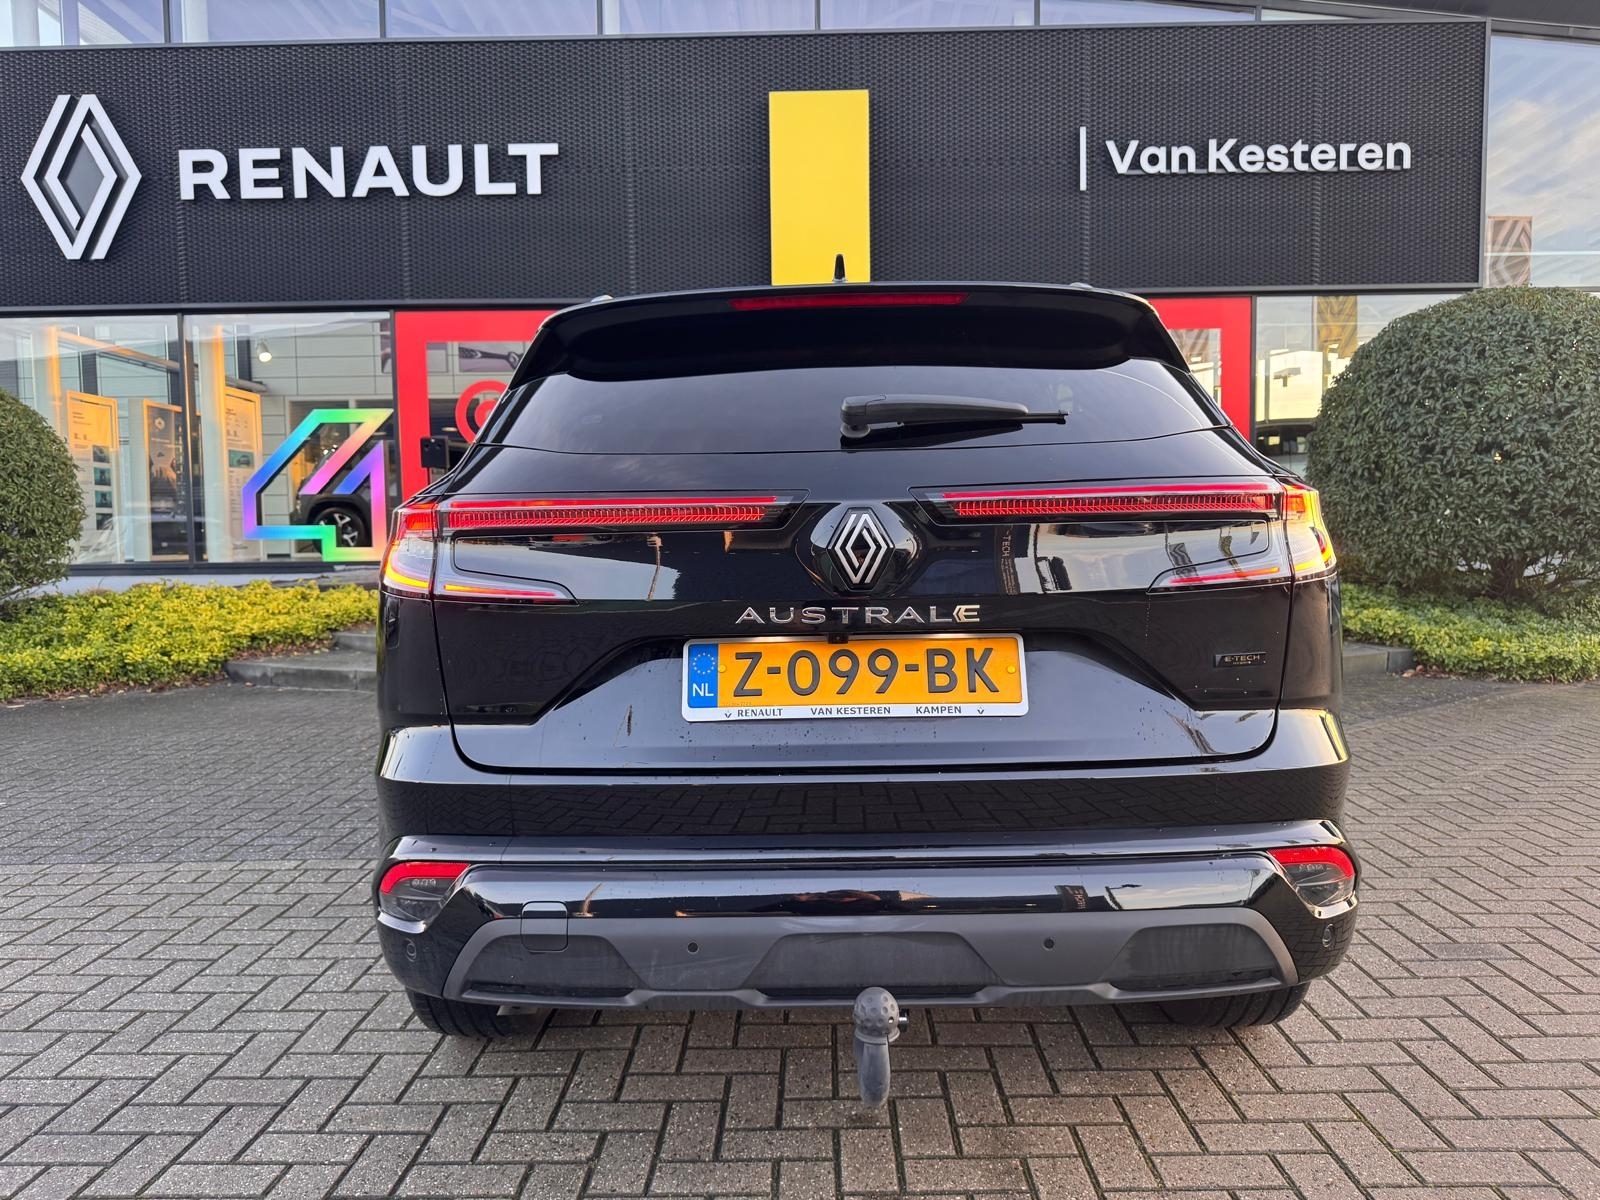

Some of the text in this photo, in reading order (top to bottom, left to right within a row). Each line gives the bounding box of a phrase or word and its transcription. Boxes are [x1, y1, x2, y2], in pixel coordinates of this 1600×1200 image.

[1105, 138, 1412, 175] Van Kesteren
[178, 142, 559, 201] RENAULT
[1223, 654, 1261, 663] E-TECH
[733, 647, 1000, 698] Z-099-BK
[692, 683, 715, 697] NL
[737, 705, 962, 718] RENAULT VAN KESTEREN KAMPEN
